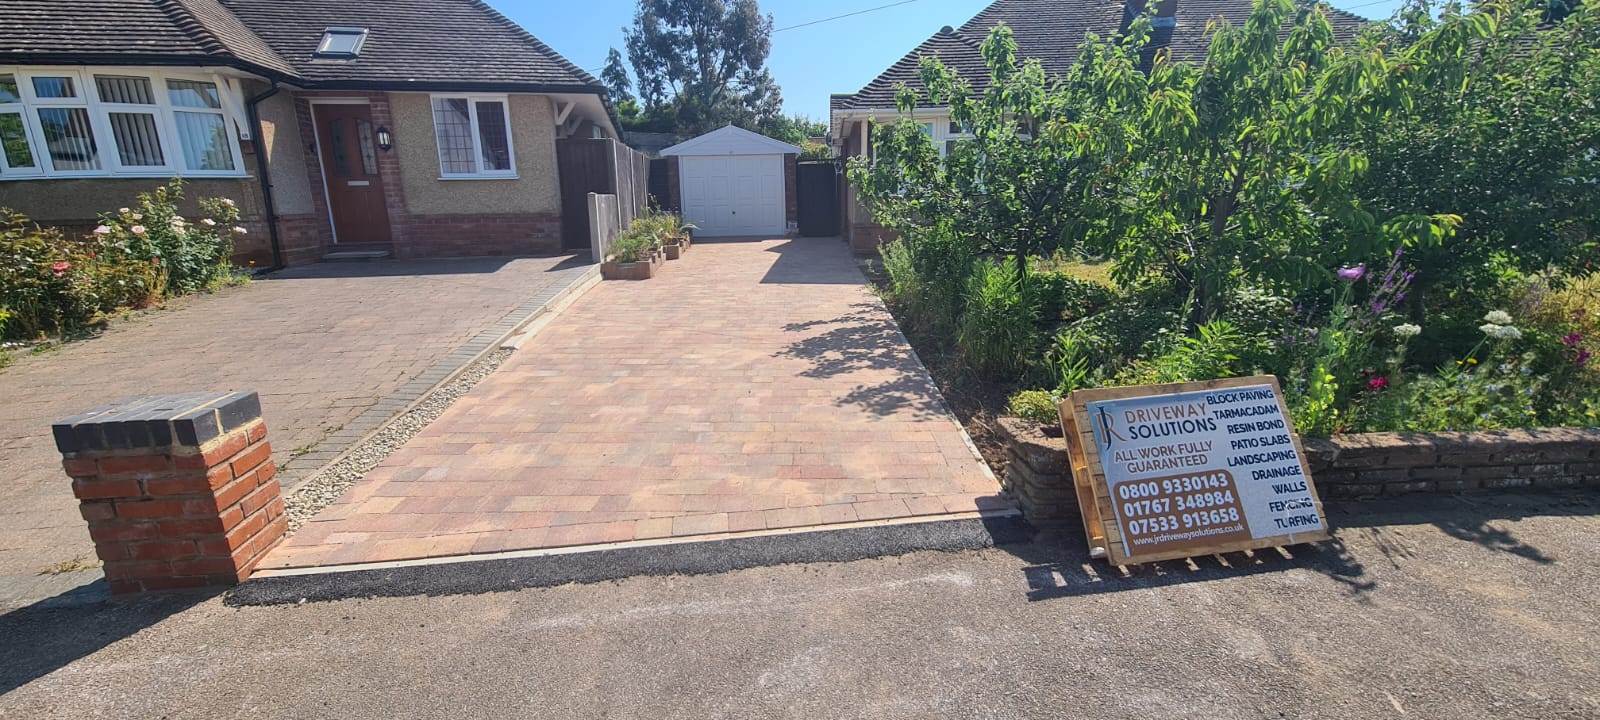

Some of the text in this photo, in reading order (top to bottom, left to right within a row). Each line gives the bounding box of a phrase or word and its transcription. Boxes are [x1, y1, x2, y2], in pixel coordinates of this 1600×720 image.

[1206, 390, 1274, 405] BLOCK PAVING
[1125, 403, 1207, 424] DRIVEWAY
[1212, 404, 1279, 420] TARMACADAM
[1129, 418, 1217, 440] SOLUTIONS
[1227, 420, 1285, 434] RESIN BOND
[1115, 440, 1213, 462] ALL WORK FULLY
[1231, 434, 1290, 450] PATIO SLABS
[1127, 454, 1208, 473] GUARANTEED
[1227, 450, 1296, 467] LANDSCAPING
[1251, 465, 1302, 481] DRAINAGE
[1120, 473, 1228, 499] 0800 9330143
[1272, 481, 1307, 494] WALLS
[1124, 490, 1234, 517] 01767 348984
[1129, 507, 1239, 535] 07533 913658
[1274, 514, 1319, 528] TURFING
[1133, 523, 1244, 545] www.jrdrivewaysolutions.co.uk
